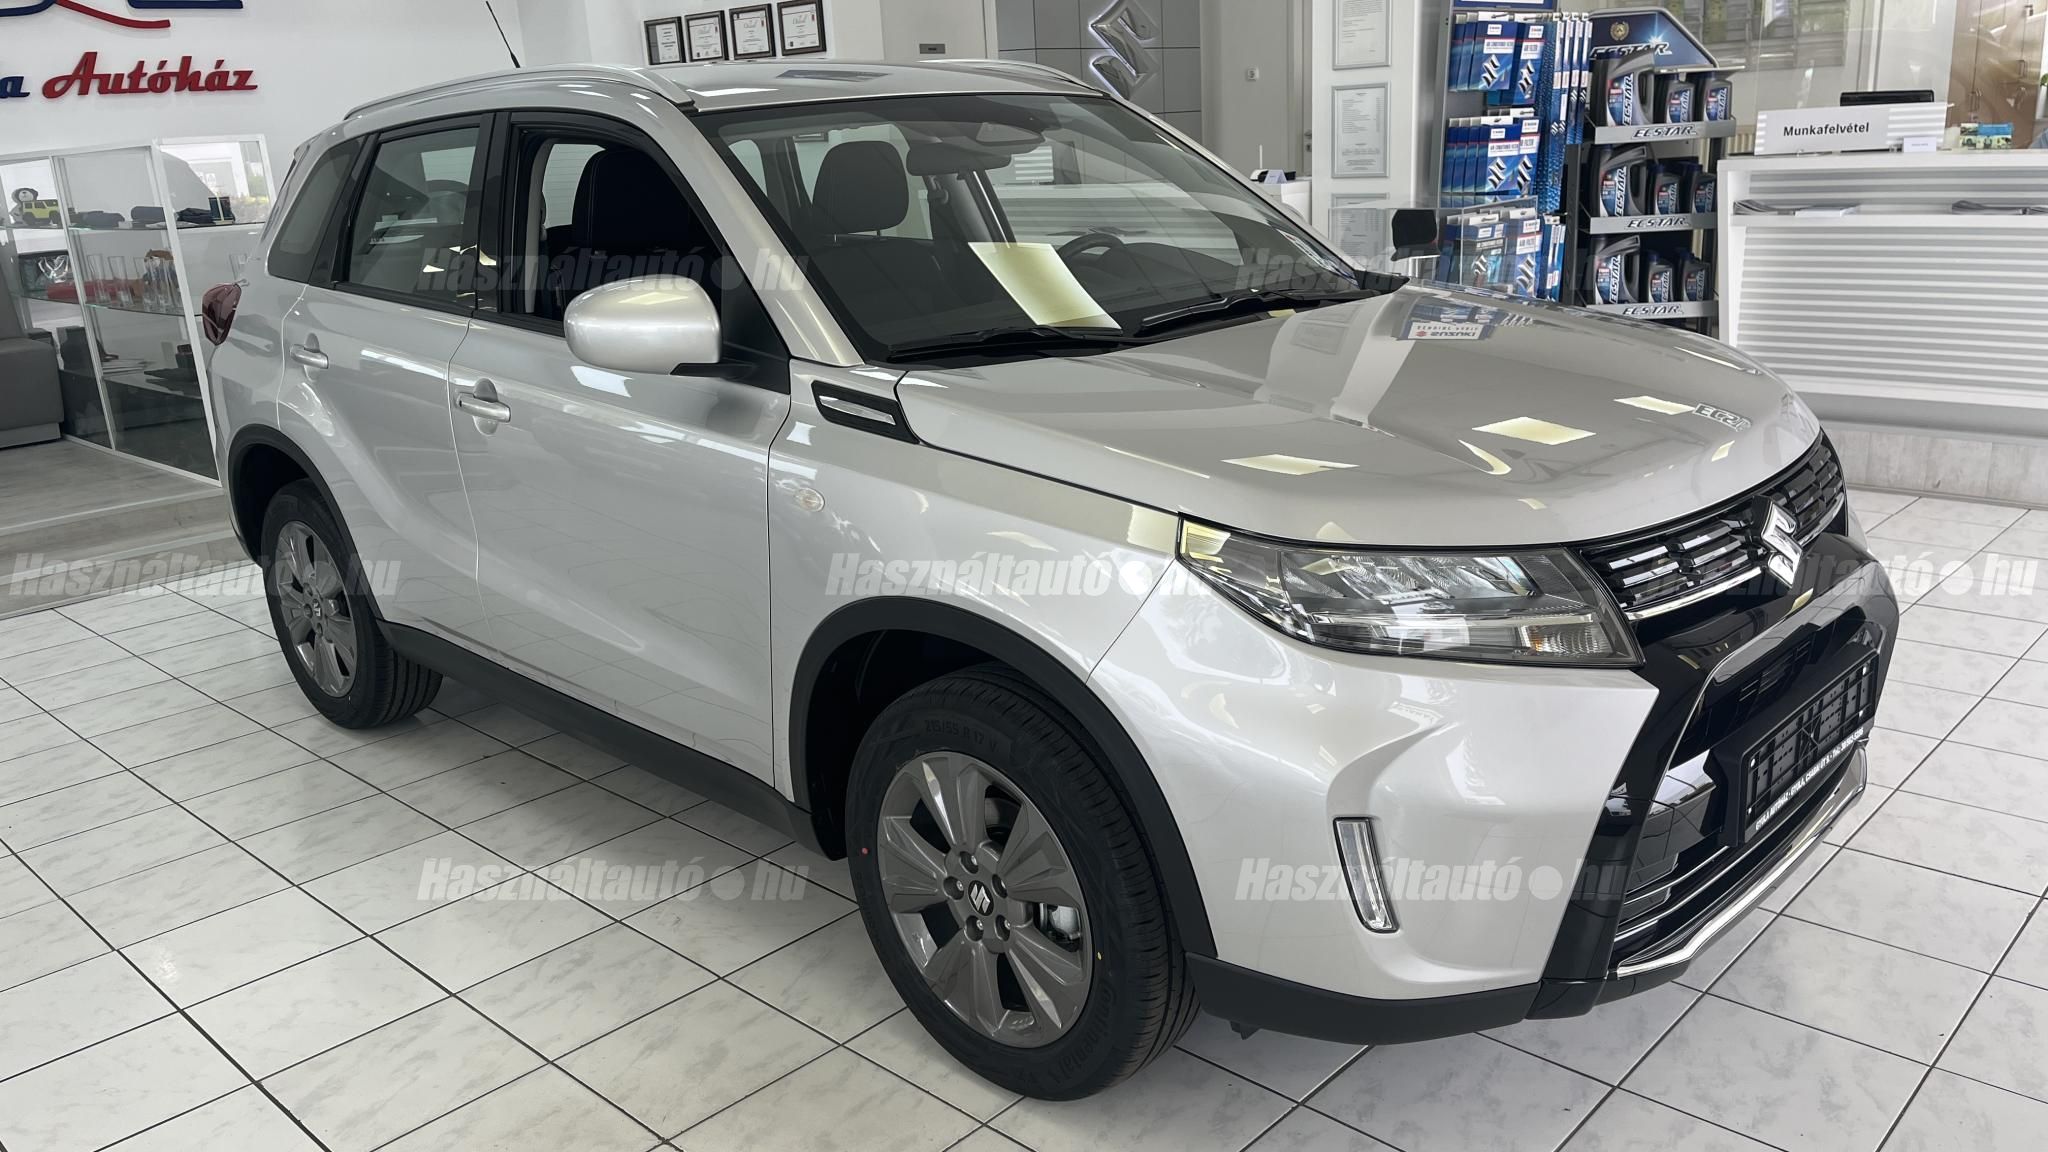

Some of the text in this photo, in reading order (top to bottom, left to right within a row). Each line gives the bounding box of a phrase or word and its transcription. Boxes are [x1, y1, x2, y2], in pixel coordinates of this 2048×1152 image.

[42, 51, 258, 99] Autóház
[1622, 72, 1634, 126] ECSTAR
[1680, 90, 1690, 122] CSTAR
[1717, 88, 1727, 120] CSTAR
[1633, 125, 1696, 139] ECSTAR
[1783, 121, 1870, 137] Munkafelvétel
[1615, 166, 1627, 217] ECSTAR
[1627, 218, 1688, 229] ECSTAR
[1608, 255, 1621, 304] ECSTAR
[1660, 272, 1670, 302] CSTAR
[1622, 305, 1684, 316] ECSTAR
